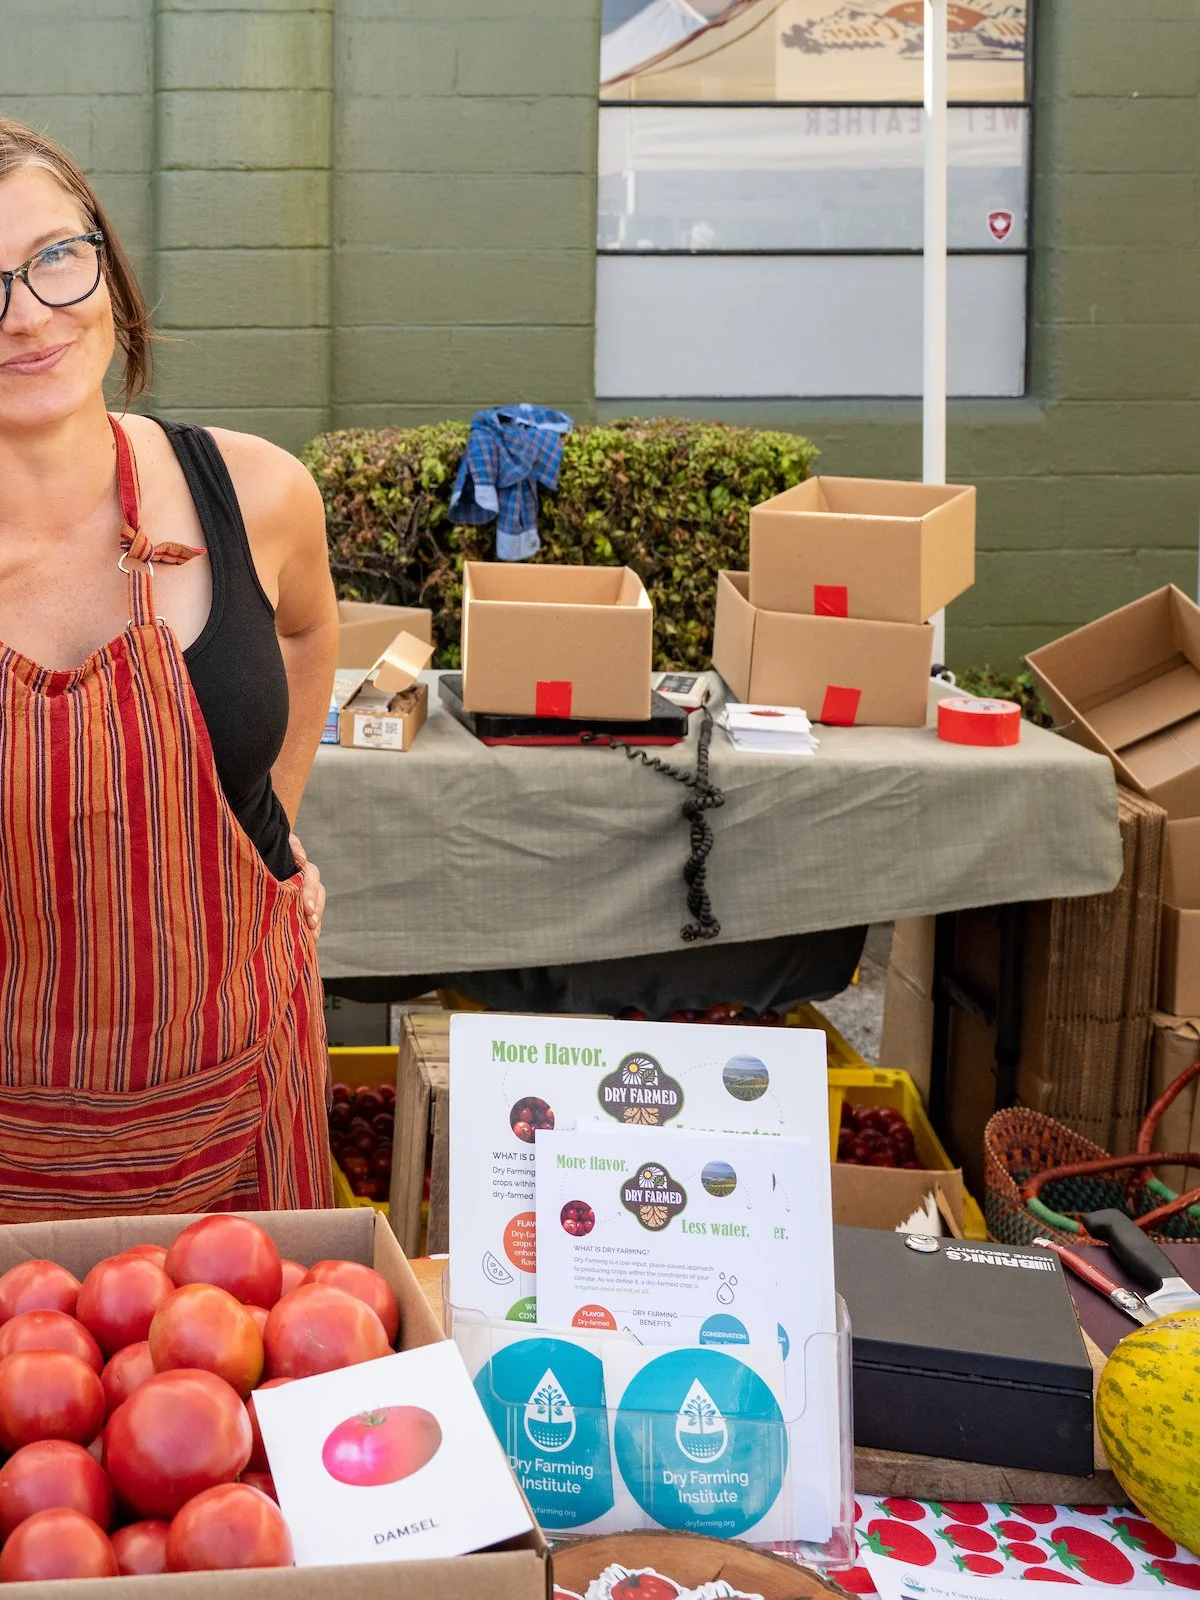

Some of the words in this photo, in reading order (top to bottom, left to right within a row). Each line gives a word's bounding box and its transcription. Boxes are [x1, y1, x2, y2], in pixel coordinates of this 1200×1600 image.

[491, 1040, 538, 1064] More
[544, 1042, 607, 1067] flavor.
[604, 1086, 628, 1103] DRY
[629, 1088, 678, 1106] FARMED
[492, 1152, 518, 1160] WHAT
[519, 1153, 528, 1161] IS
[556, 1154, 586, 1169] More
[590, 1156, 629, 1172] flavor.
[492, 1166, 505, 1175] Dry
[507, 1167, 536, 1177] Farming
[492, 1191, 534, 1200] dry-farmed
[625, 1189, 643, 1202] DRY
[645, 1190, 682, 1205] FARMED
[682, 1219, 707, 1235] Less
[711, 1222, 750, 1238] water.
[512, 1240, 532, 1249] crops
[602, 1246, 616, 1254] DRY
[617, 1247, 650, 1256] FARMING?
[944, 1246, 1011, 1258] SECURITY
[945, 1250, 1040, 1269] BRINKS
[1013, 1252, 1054, 1262] HOME
[519, 1311, 537, 1319] CON
[582, 1310, 605, 1318] FLAVOR
[632, 1309, 646, 1317] DRY
[647, 1310, 678, 1319] FARMING
[577, 1318, 610, 1328] Dry-farmed
[639, 1319, 672, 1328] BENEFITS
[702, 1331, 747, 1341] CONSERVATION
[508, 1455, 532, 1474] Dry
[535, 1457, 594, 1480] Farming
[663, 1470, 687, 1487] Dry
[690, 1470, 749, 1487] Farming
[521, 1475, 582, 1494] Institute
[678, 1488, 738, 1504] Institute
[531, 1506, 577, 1518] yfarming.org
[685, 1518, 736, 1528] dryfarming.org
[373, 1518, 440, 1545] DAMSEL
